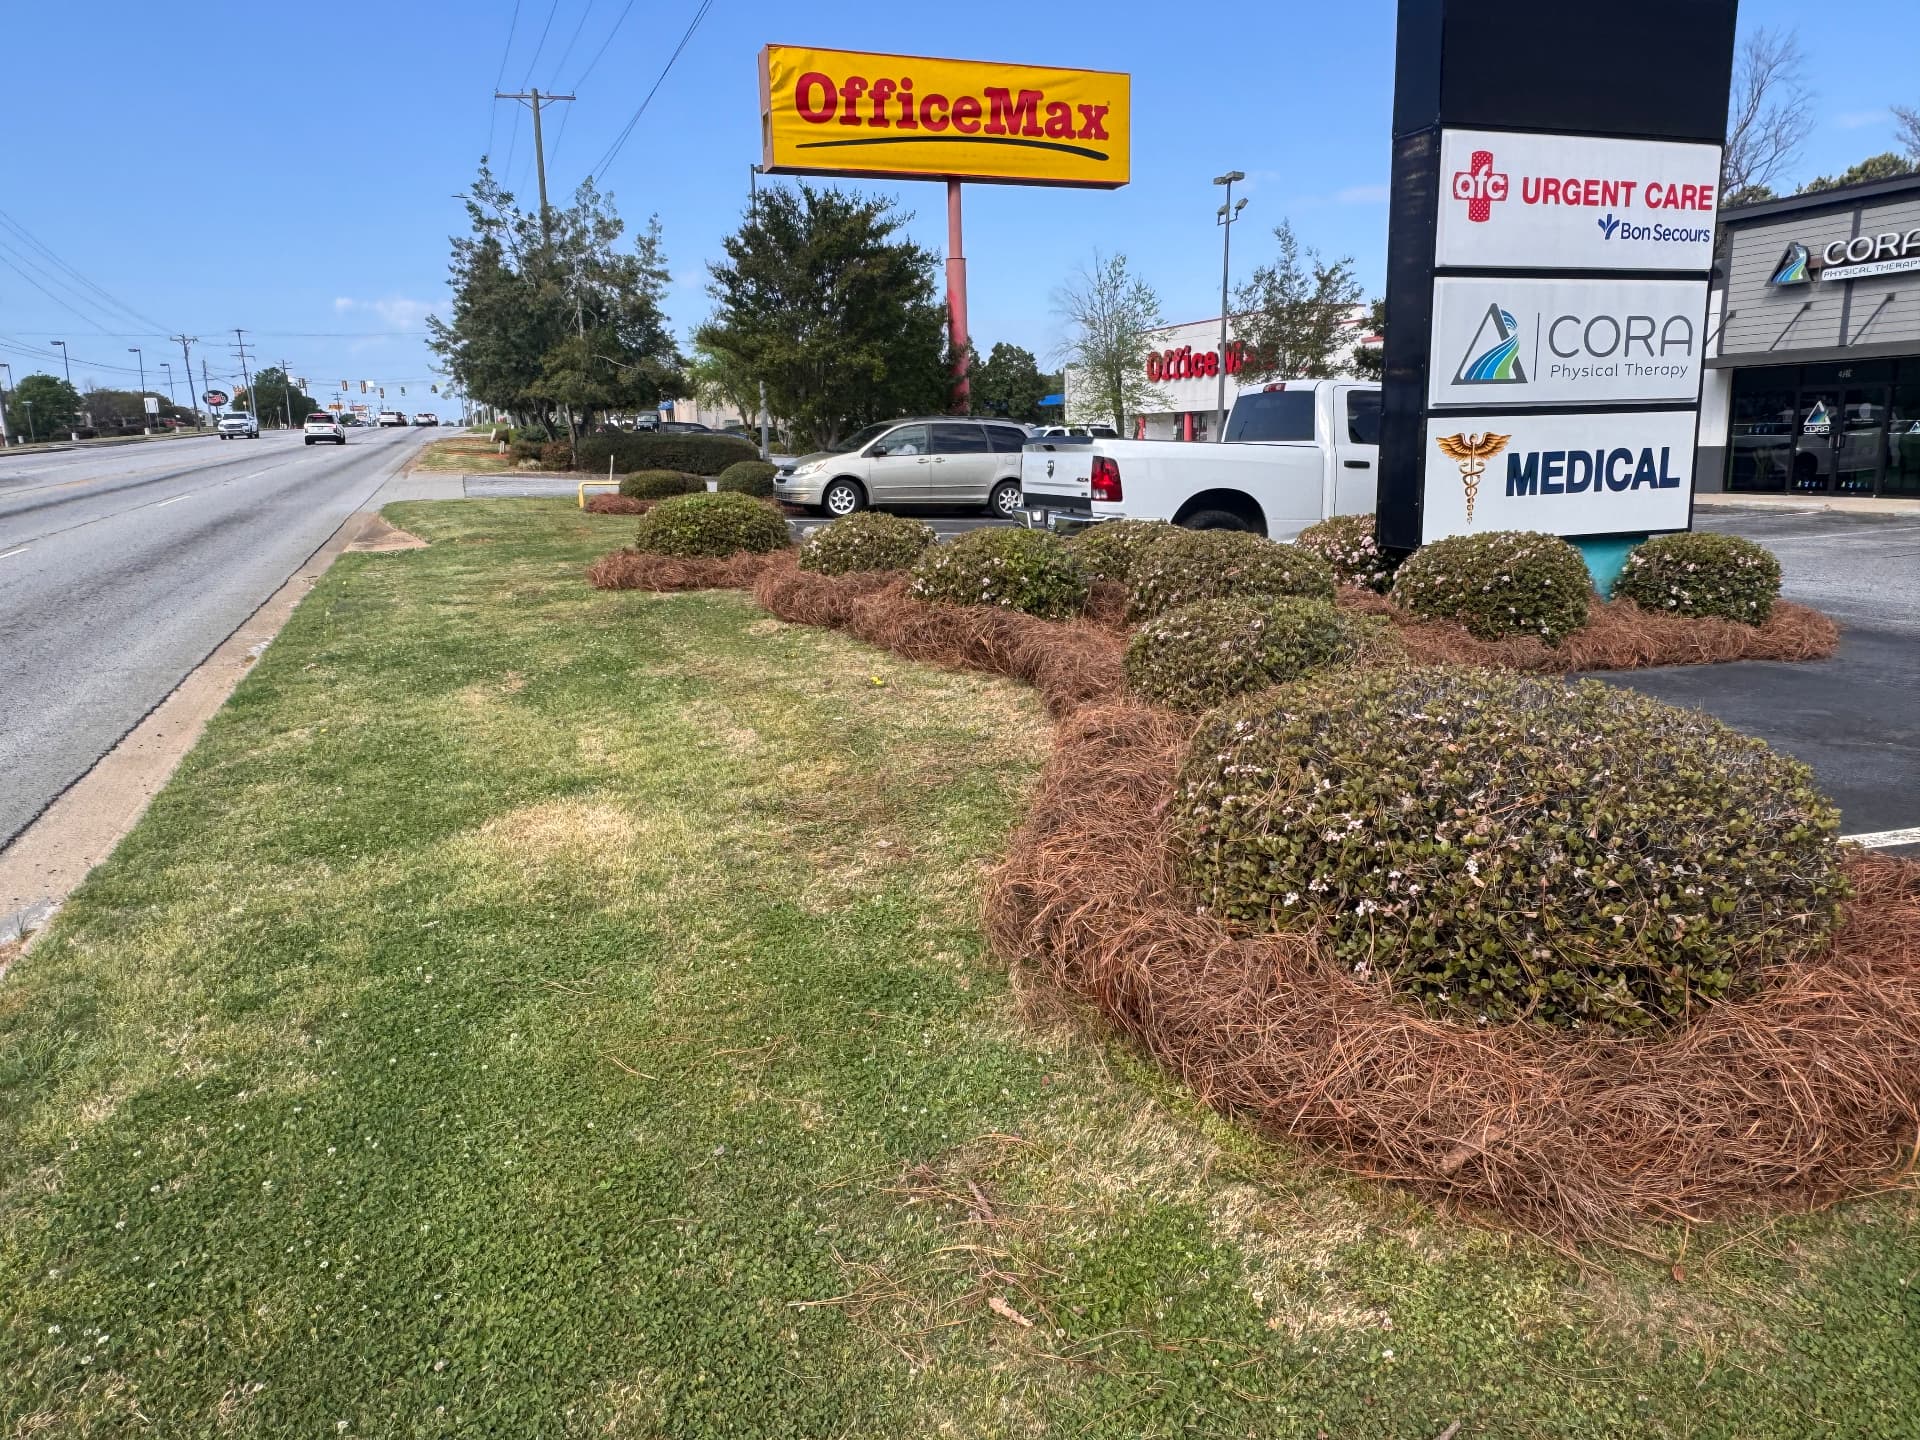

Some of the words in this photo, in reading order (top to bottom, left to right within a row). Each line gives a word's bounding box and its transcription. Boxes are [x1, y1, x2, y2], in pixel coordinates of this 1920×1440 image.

[795, 71, 1110, 140] OfficeMax
[1454, 164, 1506, 200] afc
[1522, 176, 1637, 208] URGENT
[1645, 182, 1714, 211] CARE
[1620, 222, 1651, 241] Bon
[1653, 224, 1711, 243] Secours
[1824, 228, 1920, 265] CORA
[1823, 266, 1873, 278] PHYSICAL
[1876, 259, 1920, 272] THERAP
[1548, 315, 1694, 358] CORA
[1146, 338, 1280, 382] OfficeM
[1550, 363, 1619, 380] Physical
[1624, 362, 1689, 378] Therapy
[1505, 447, 1681, 497] MEDICAL
